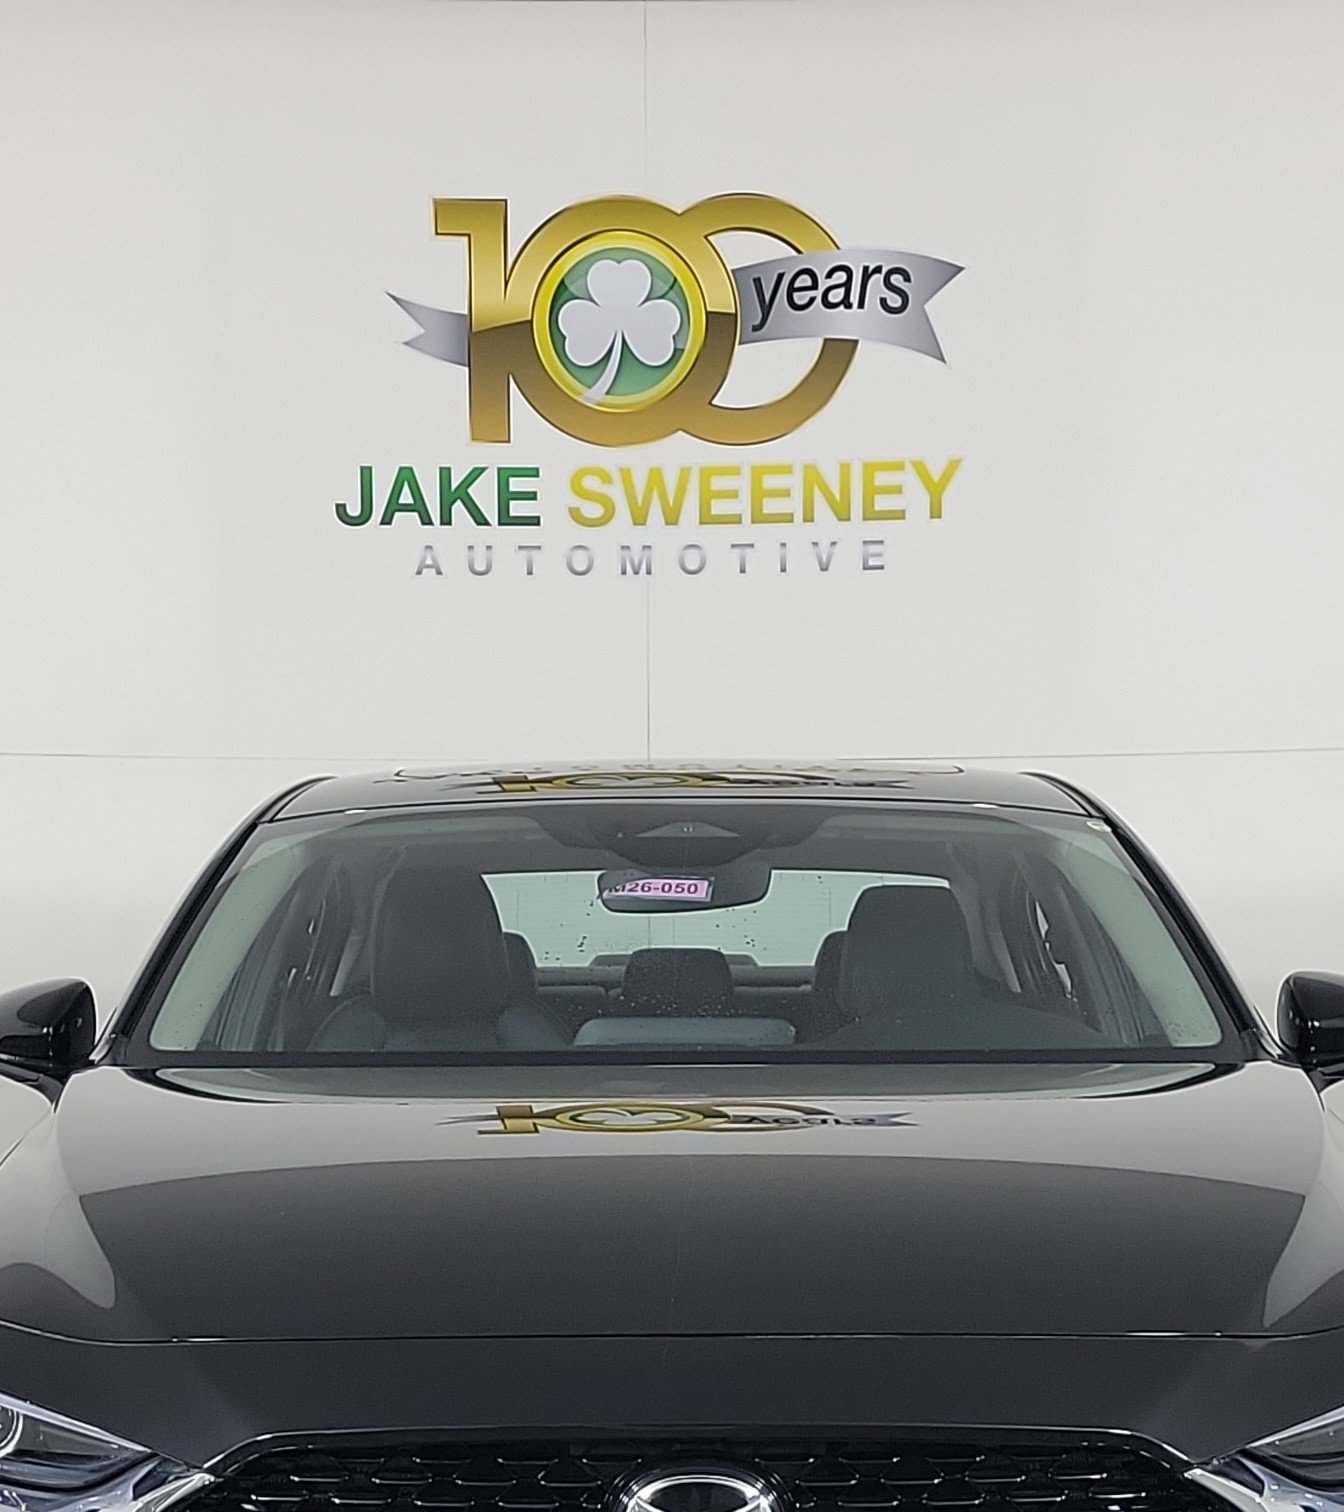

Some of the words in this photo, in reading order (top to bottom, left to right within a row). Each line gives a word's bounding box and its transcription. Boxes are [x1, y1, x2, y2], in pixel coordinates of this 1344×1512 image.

[433, 192, 860, 446] 100
[751, 257, 913, 333] years
[334, 465, 542, 528] JAKE
[567, 458, 963, 528] SWEENEY
[414, 540, 886, 578] AUTOMOTIVE
